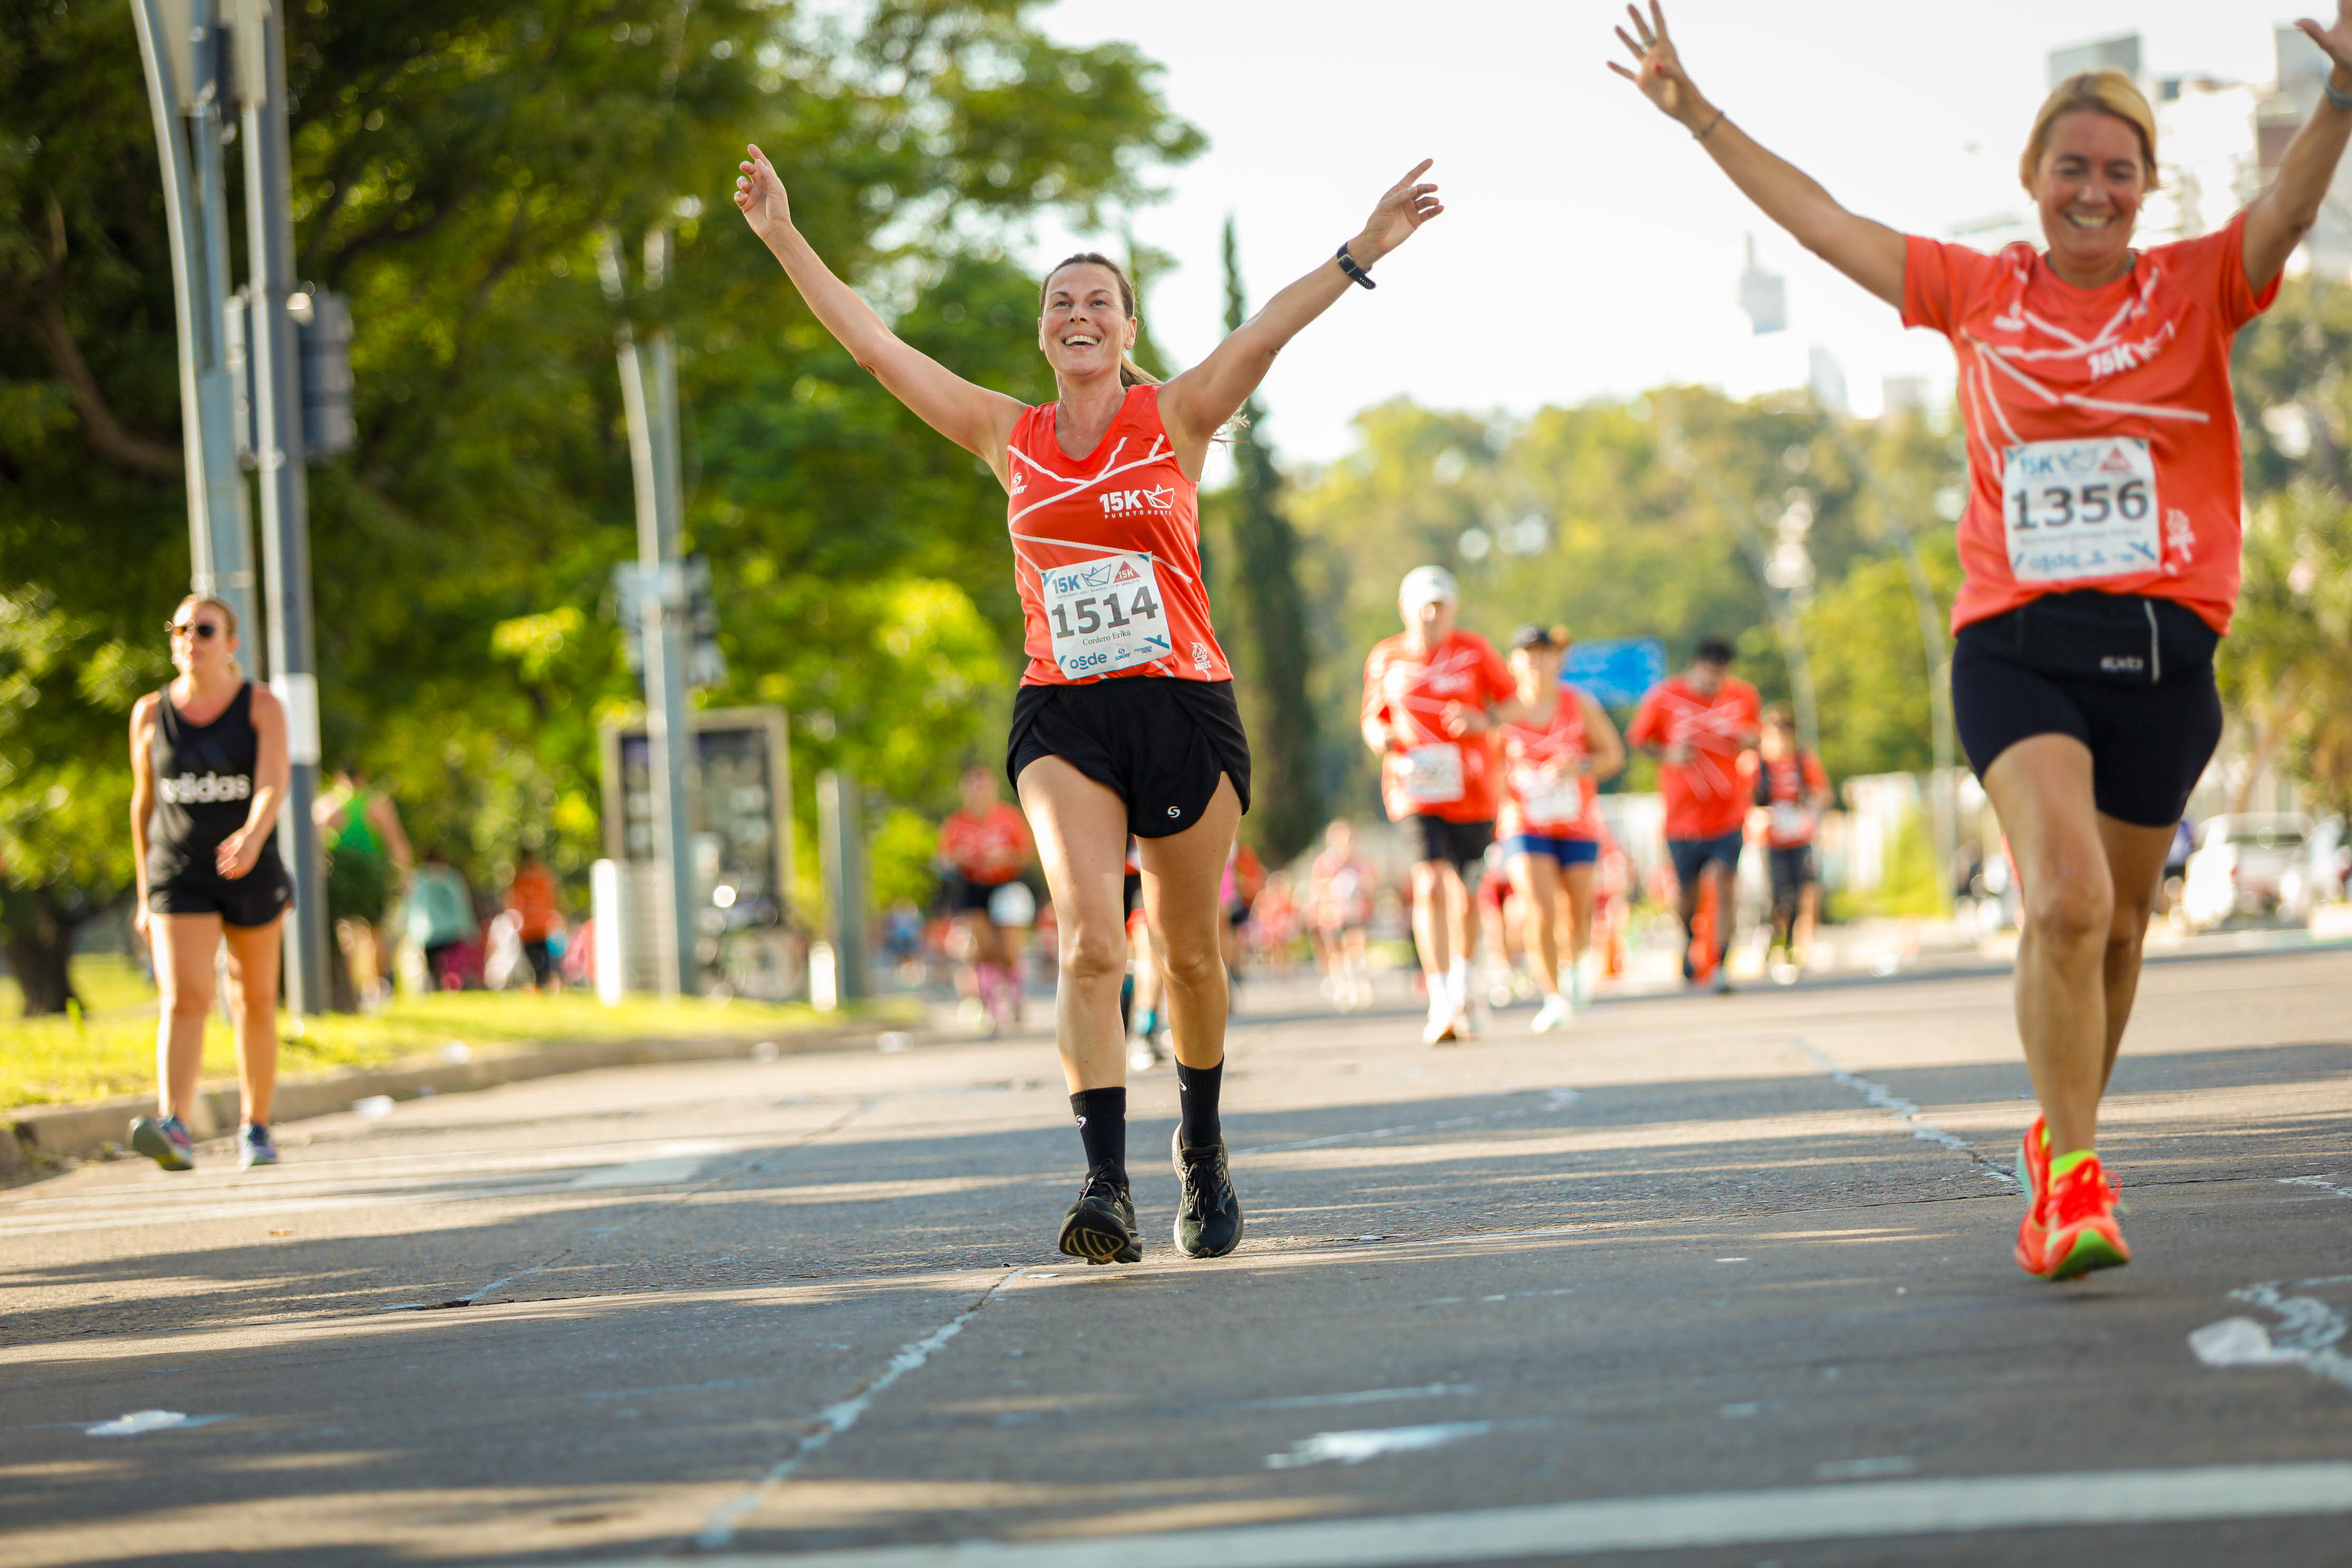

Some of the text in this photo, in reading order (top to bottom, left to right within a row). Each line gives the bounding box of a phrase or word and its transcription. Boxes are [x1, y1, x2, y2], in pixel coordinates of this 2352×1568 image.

[2088, 343, 2137, 381] 15K
[2021, 455, 2054, 474] 15K
[1100, 490, 1143, 513] 15K
[2012, 479, 2149, 531] 1356
[1104, 510, 1144, 519] PUERTO
[1119, 569, 1134, 579] 15K
[1052, 574, 1081, 594] 15K
[1051, 586, 1158, 639] 1514
[1083, 630, 1131, 645] Cordero Erika
[1070, 651, 1108, 670] osde
[1194, 660, 1212, 671] ARDEC
